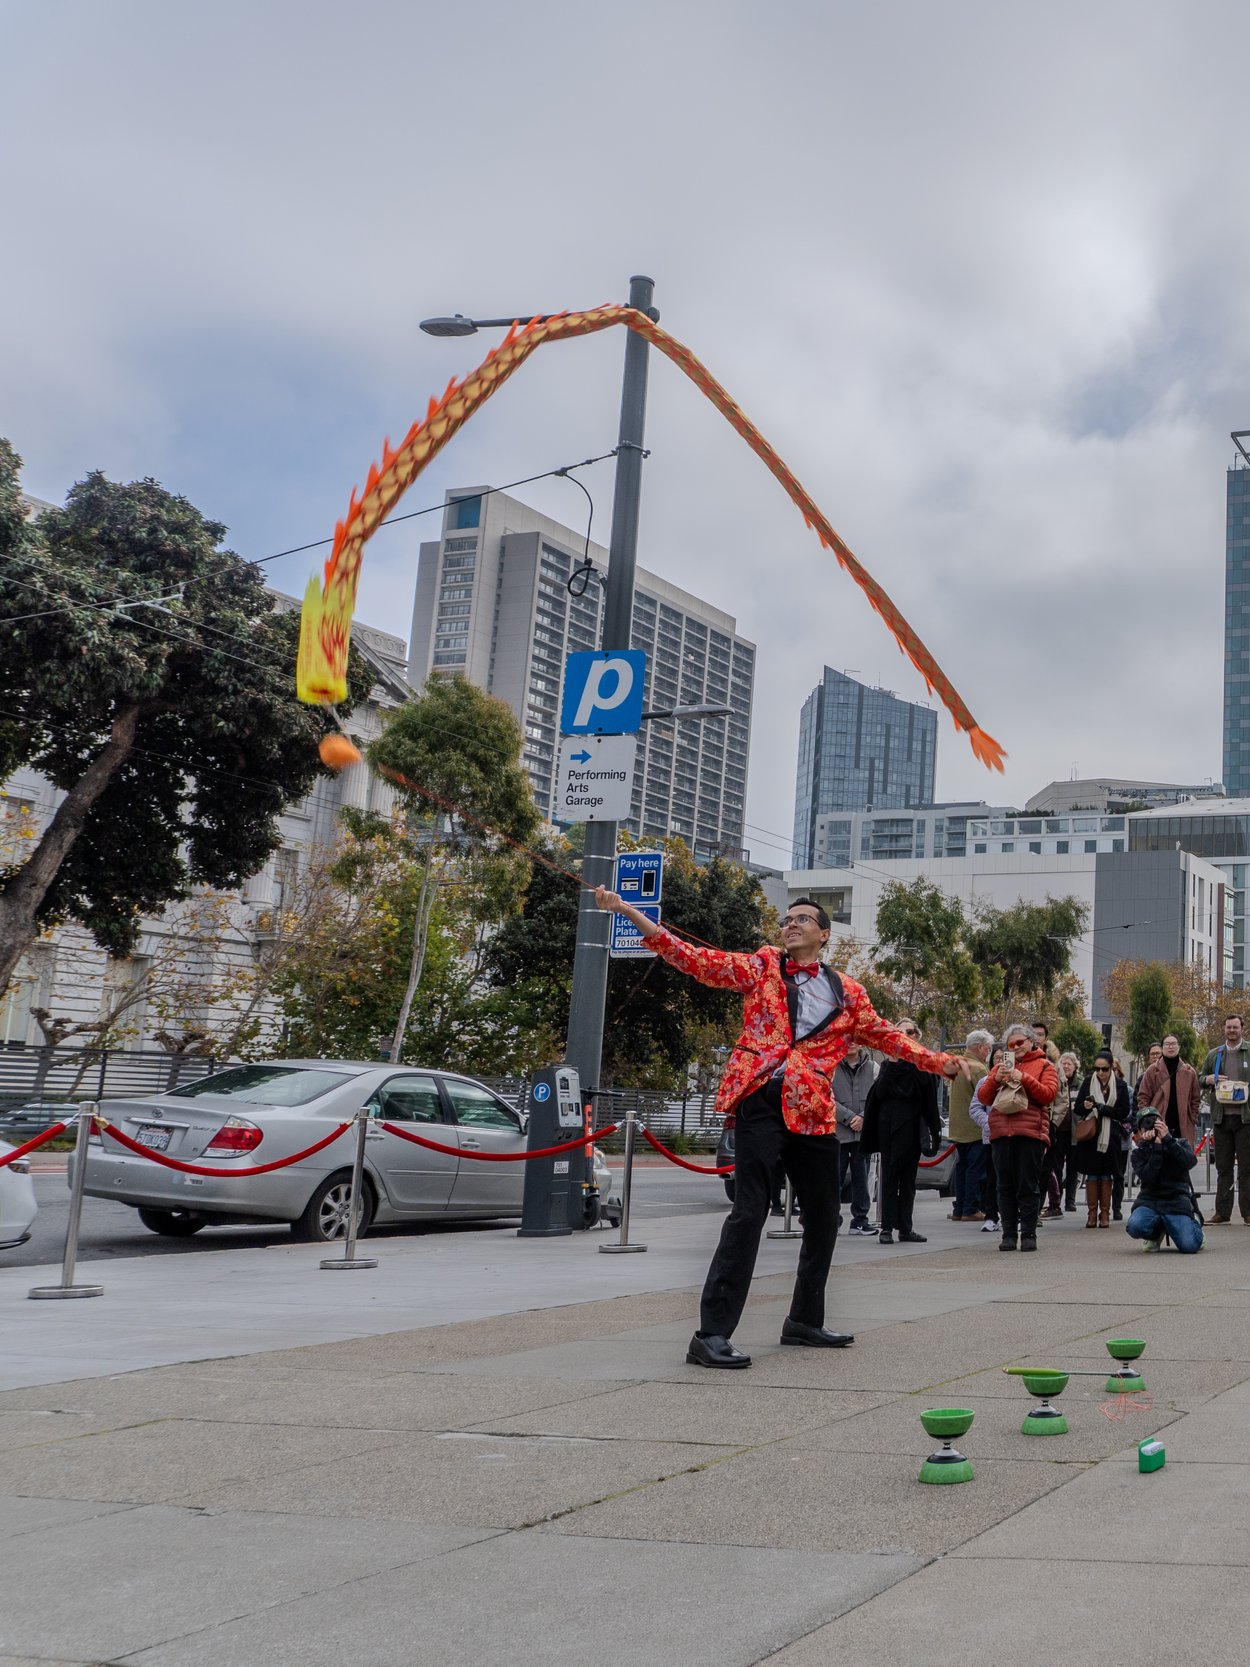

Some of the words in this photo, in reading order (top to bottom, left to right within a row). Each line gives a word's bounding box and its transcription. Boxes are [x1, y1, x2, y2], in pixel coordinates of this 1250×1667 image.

[568, 769, 626, 782] Performing
[566, 782, 589, 793] Arts
[565, 795, 604, 808] Garage
[620, 859, 637, 871] Pay
[638, 858, 659, 868] here
[616, 917, 635, 927] Lice
[616, 927, 638, 936] Plate
[616, 939, 640, 947] 70104
[538, 1086, 547, 1099] P
